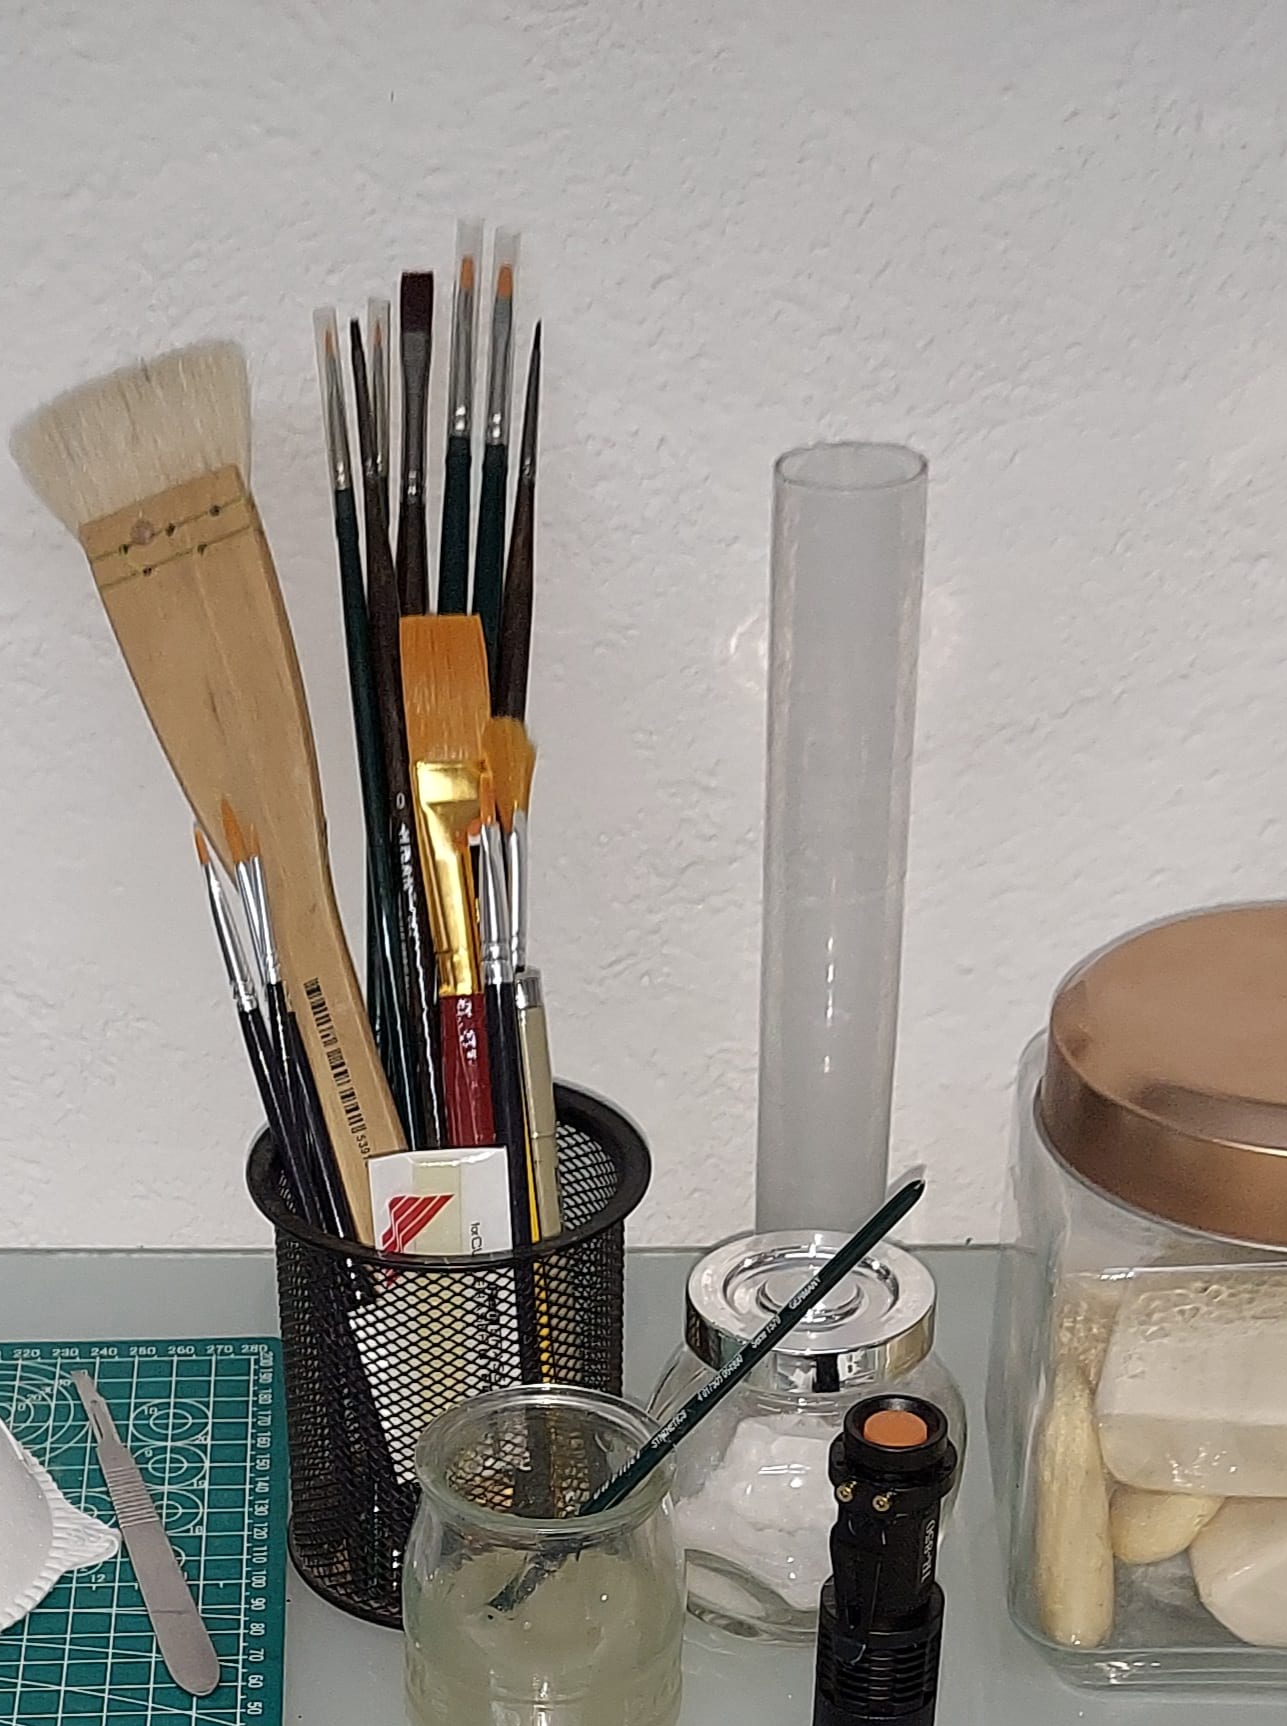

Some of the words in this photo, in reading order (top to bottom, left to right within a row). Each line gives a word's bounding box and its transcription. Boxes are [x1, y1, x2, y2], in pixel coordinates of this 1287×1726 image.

[90, 1346, 118, 1357] 240
[206, 1344, 234, 1355] 270
[257, 1410, 272, 1427] 170
[255, 1452, 270, 1471] 150
[254, 1475, 270, 1493] 140
[253, 1498, 269, 1516] 130
[252, 1521, 268, 1540] 120
[252, 1544, 267, 1564] 110
[251, 1569, 267, 1588] 100
[250, 1597, 266, 1611] 90
[249, 1622, 266, 1637] 80
[248, 1648, 265, 1662] 70
[247, 1674, 264, 1688] 60
[246, 1701, 263, 1715] 50
